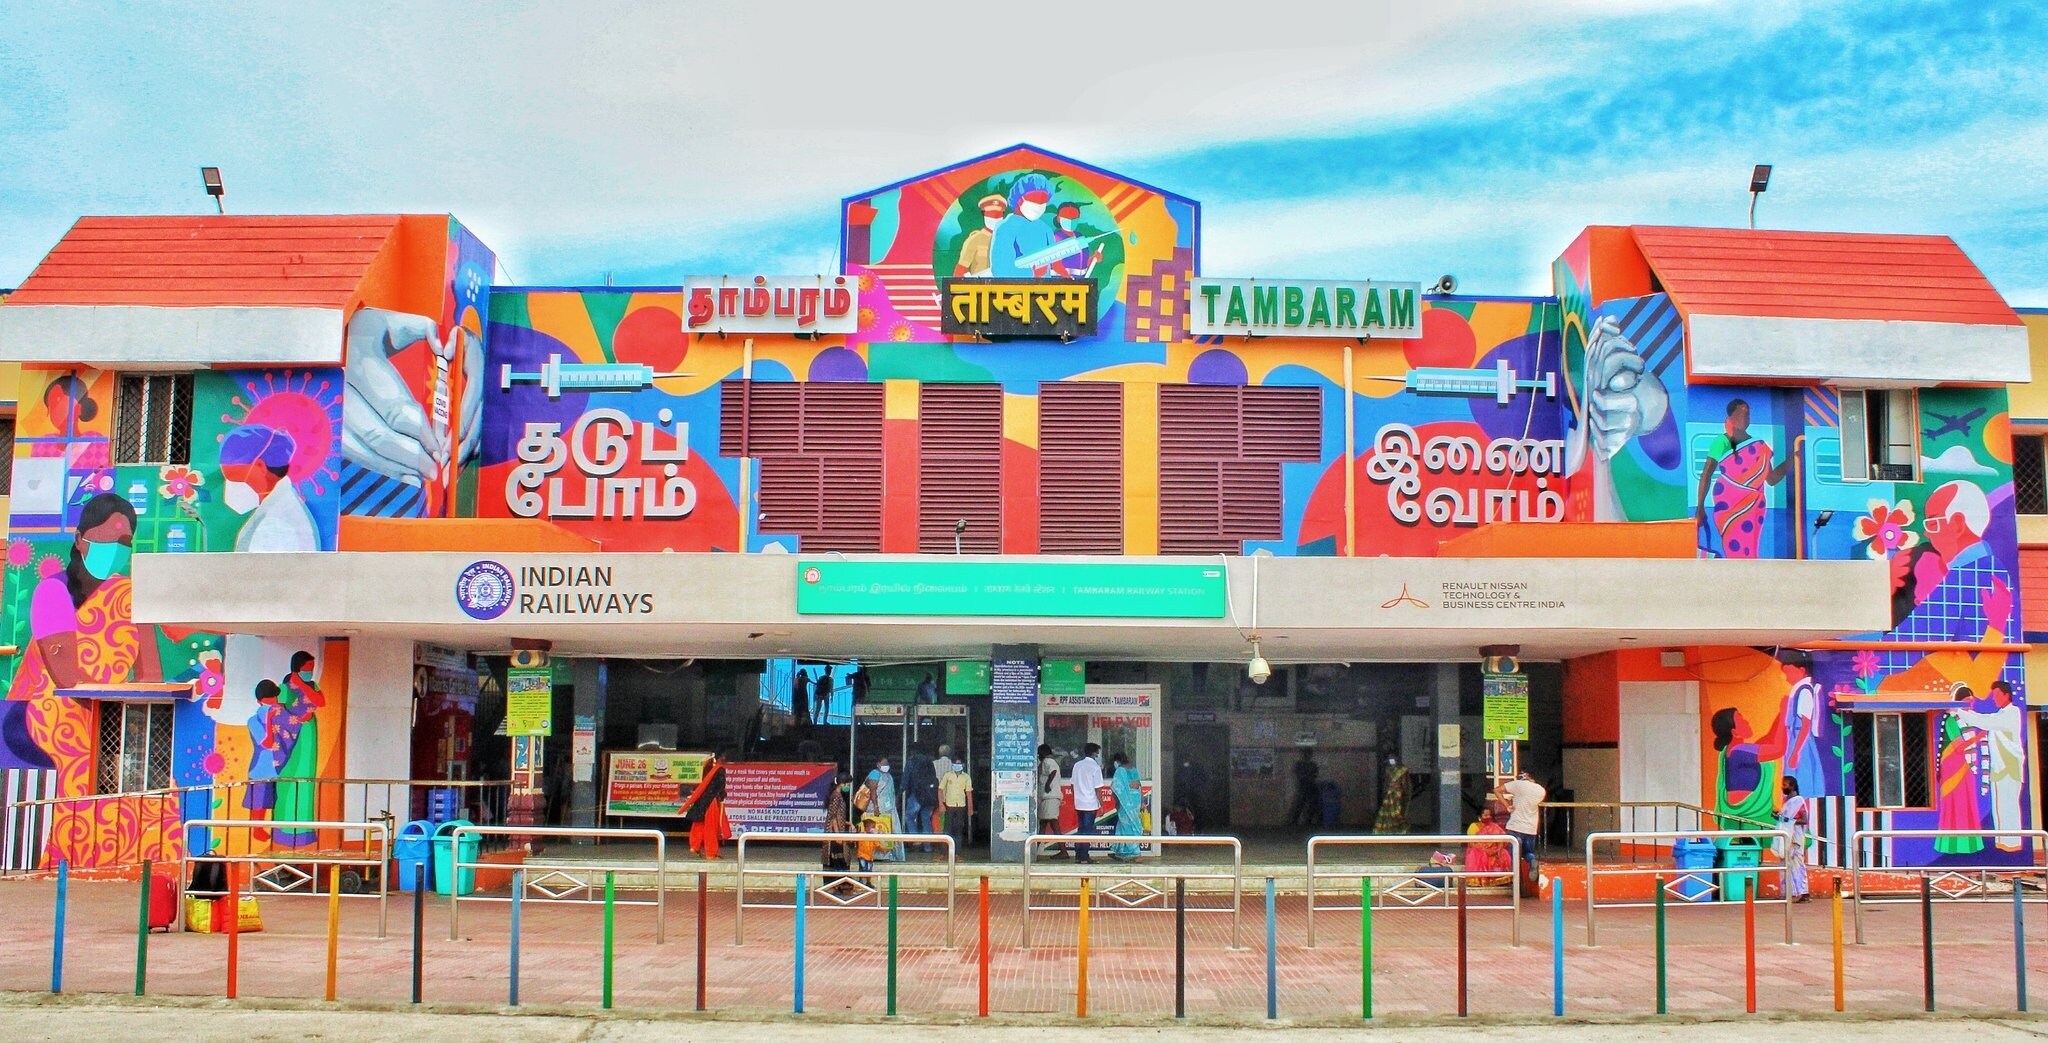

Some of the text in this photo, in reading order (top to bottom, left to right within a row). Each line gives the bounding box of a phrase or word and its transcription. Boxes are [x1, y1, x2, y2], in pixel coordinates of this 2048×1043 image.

[688, 276, 851, 328] தாம்பரம்
[950, 283, 1089, 324] ताम्बरम
[1200, 285, 1414, 329] TAMBARAM
[521, 566, 612, 586] INDIAN
[482, 563, 512, 607] INDIAN RAILWAYS
[1073, 586, 1205, 597] TAMBARAM RAILWAY STATION
[1442, 582, 1527, 590] RENAULT NISSAN
[520, 594, 654, 614] RAILWAYS
[1442, 592, 1520, 600] TECHNOLOGY &
[1069, 696, 1095, 704] ASSISTANCE
[1092, 716, 1123, 728] HELP
[1126, 716, 1150, 728] YOU
[616, 759, 646, 769] JUNE 26
